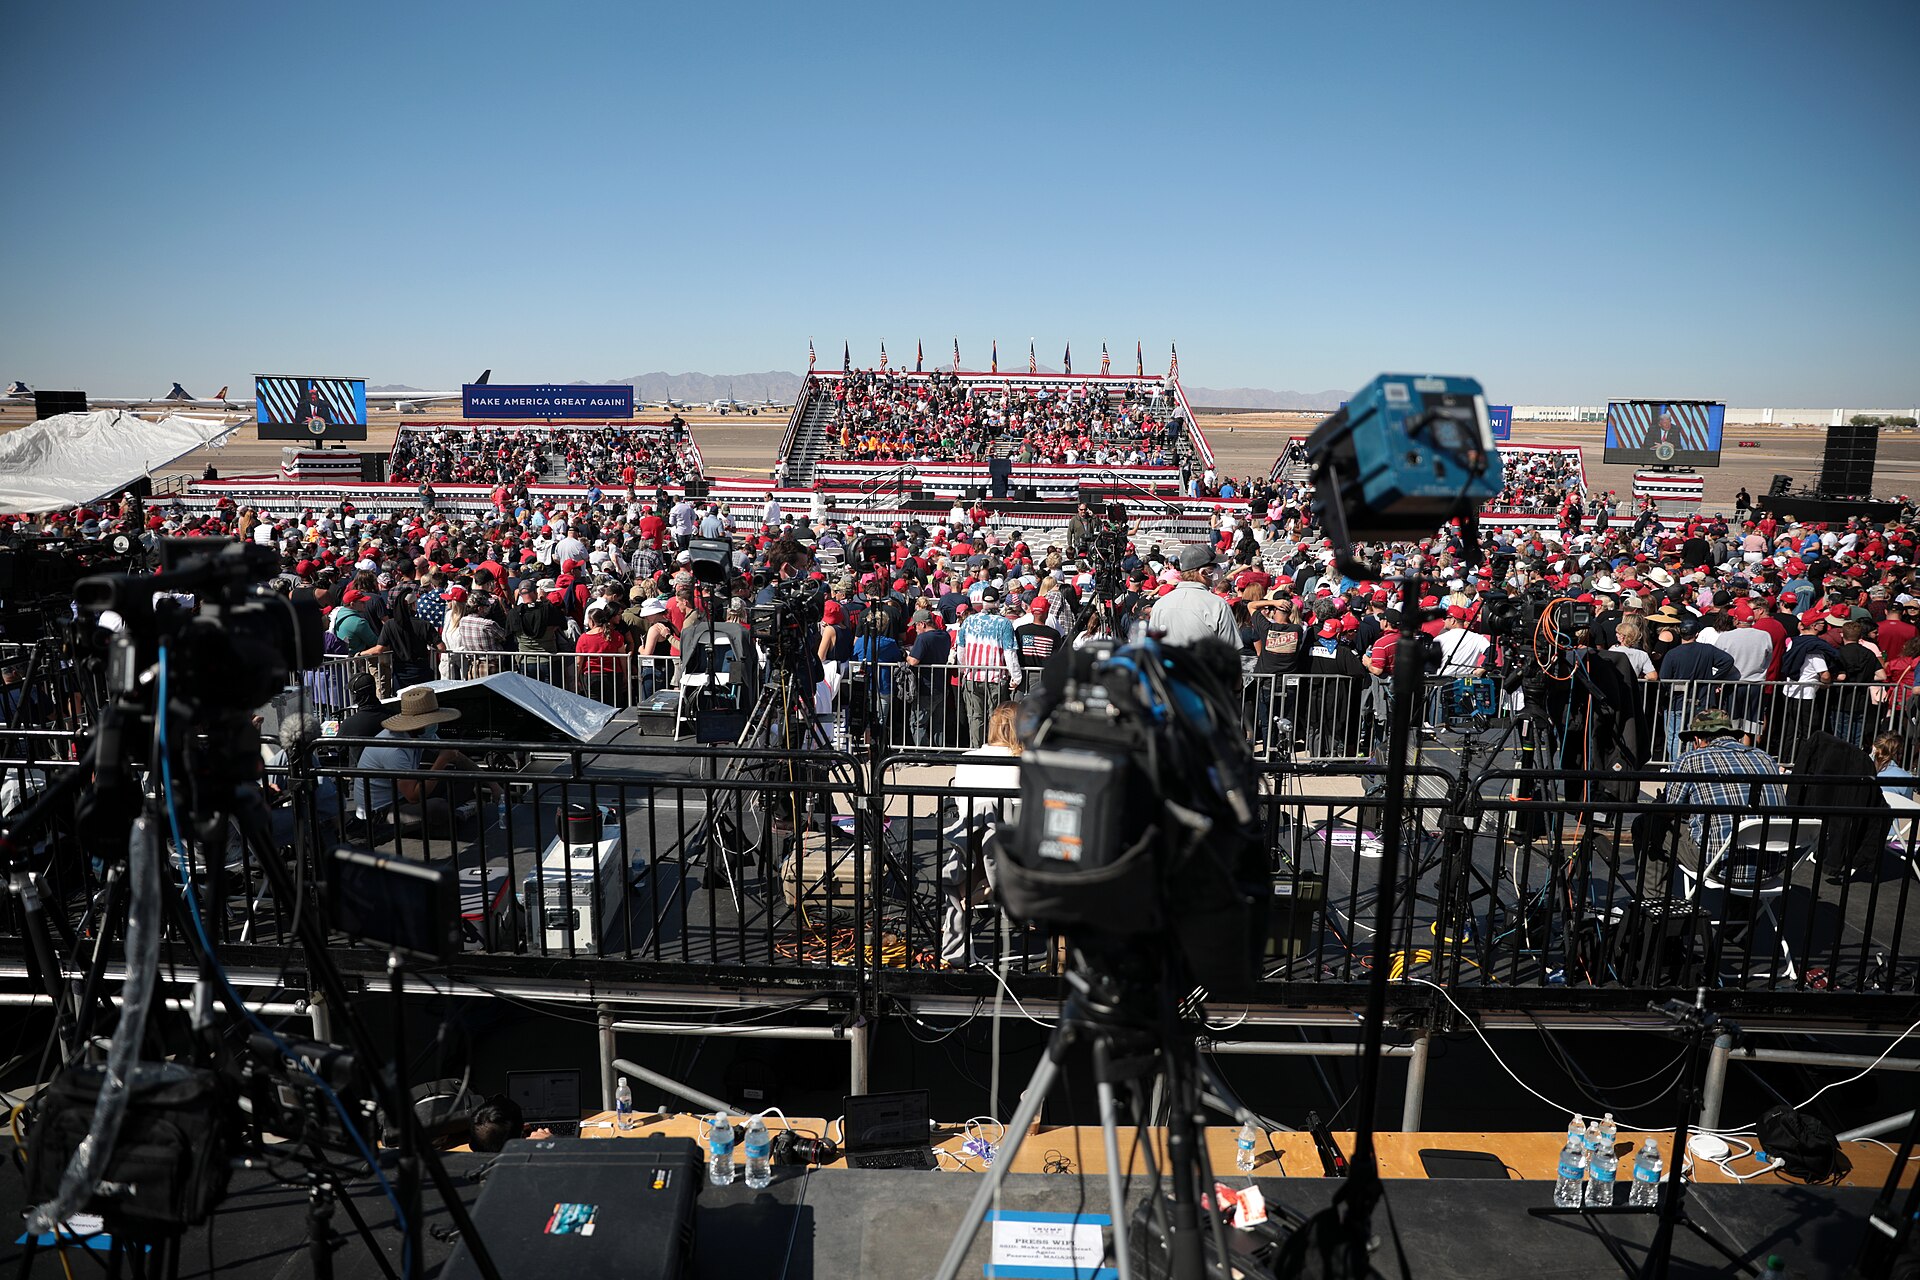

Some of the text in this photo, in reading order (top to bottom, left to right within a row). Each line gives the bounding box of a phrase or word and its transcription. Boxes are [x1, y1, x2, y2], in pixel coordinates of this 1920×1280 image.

[471, 398, 625, 406] MAKE AMERICA GREAT AGAIN!
[1268, 633, 1296, 646] DAD'S
